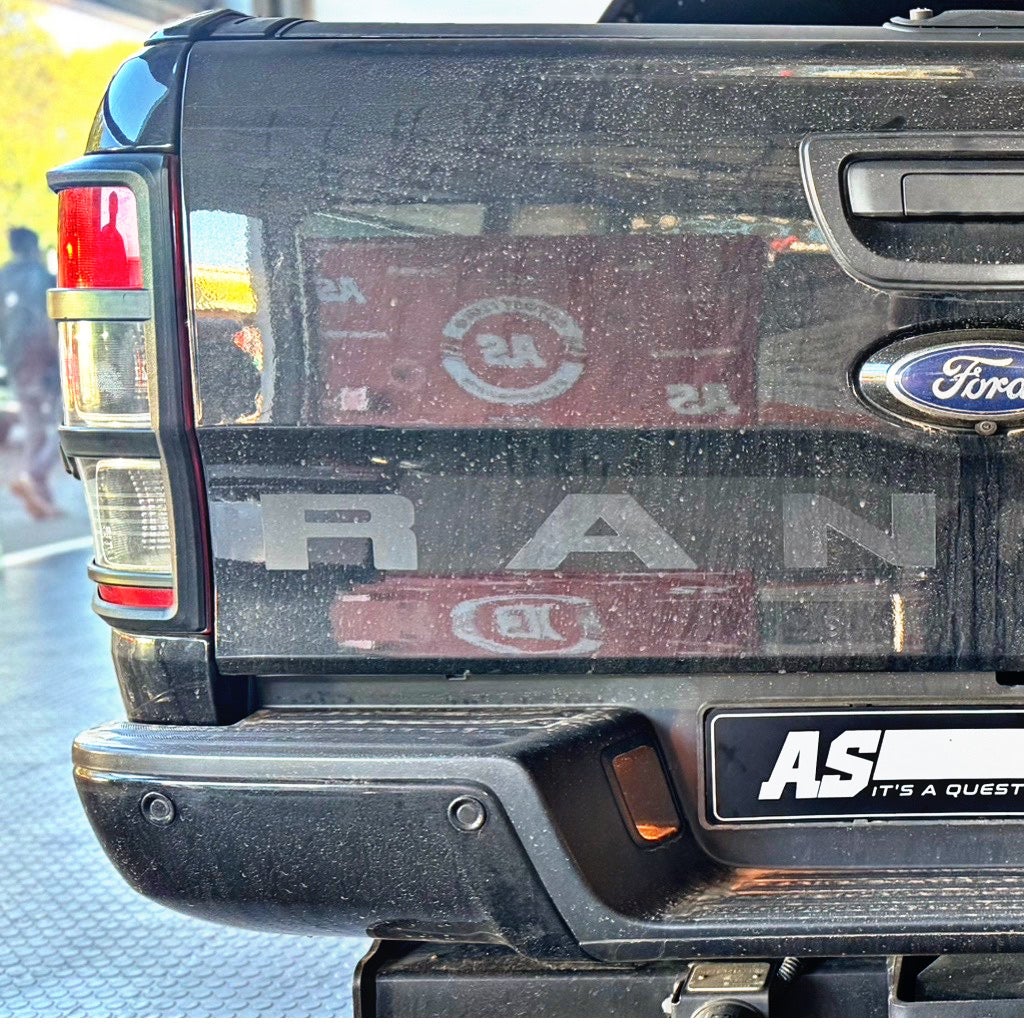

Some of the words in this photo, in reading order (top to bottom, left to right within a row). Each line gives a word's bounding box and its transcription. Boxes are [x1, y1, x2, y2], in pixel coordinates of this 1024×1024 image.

[758, 729, 882, 800] AS
[871, 784, 914, 798] IT'S
[920, 784, 937, 797] A
